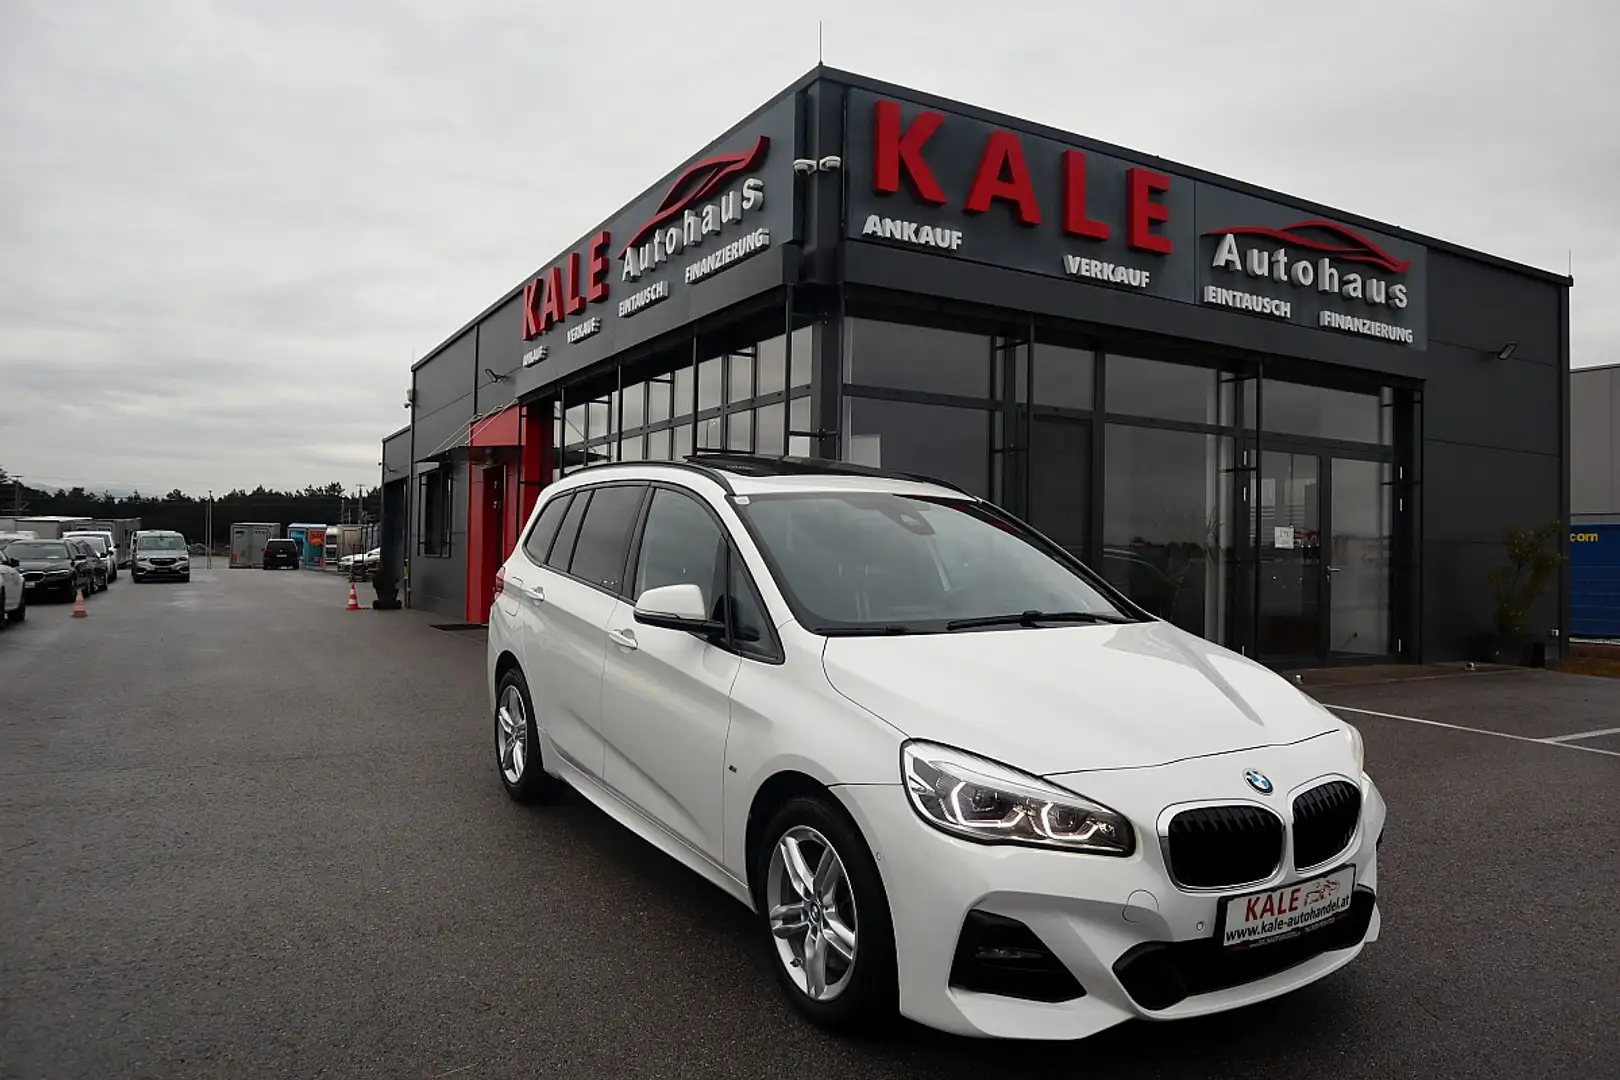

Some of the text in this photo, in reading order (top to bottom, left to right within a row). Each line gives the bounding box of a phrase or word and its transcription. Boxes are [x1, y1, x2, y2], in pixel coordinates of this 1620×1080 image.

[873, 99, 1172, 255] KALE
[622, 178, 764, 282] Autohaus
[862, 214, 963, 250] ANKAUF
[685, 227, 770, 284] FINANZIERUNG
[1063, 254, 1150, 288] VERKAUF
[1212, 233, 1408, 309] Autohaus
[522, 231, 610, 341] KALE
[619, 280, 669, 318] EINTAUSCH
[1204, 285, 1291, 318] EINTAUSCH
[1319, 310, 1413, 344] FINANZIERUNG
[1225, 895, 1349, 942] www.kale-autohandel.at
[1244, 888, 1301, 922] KALE
